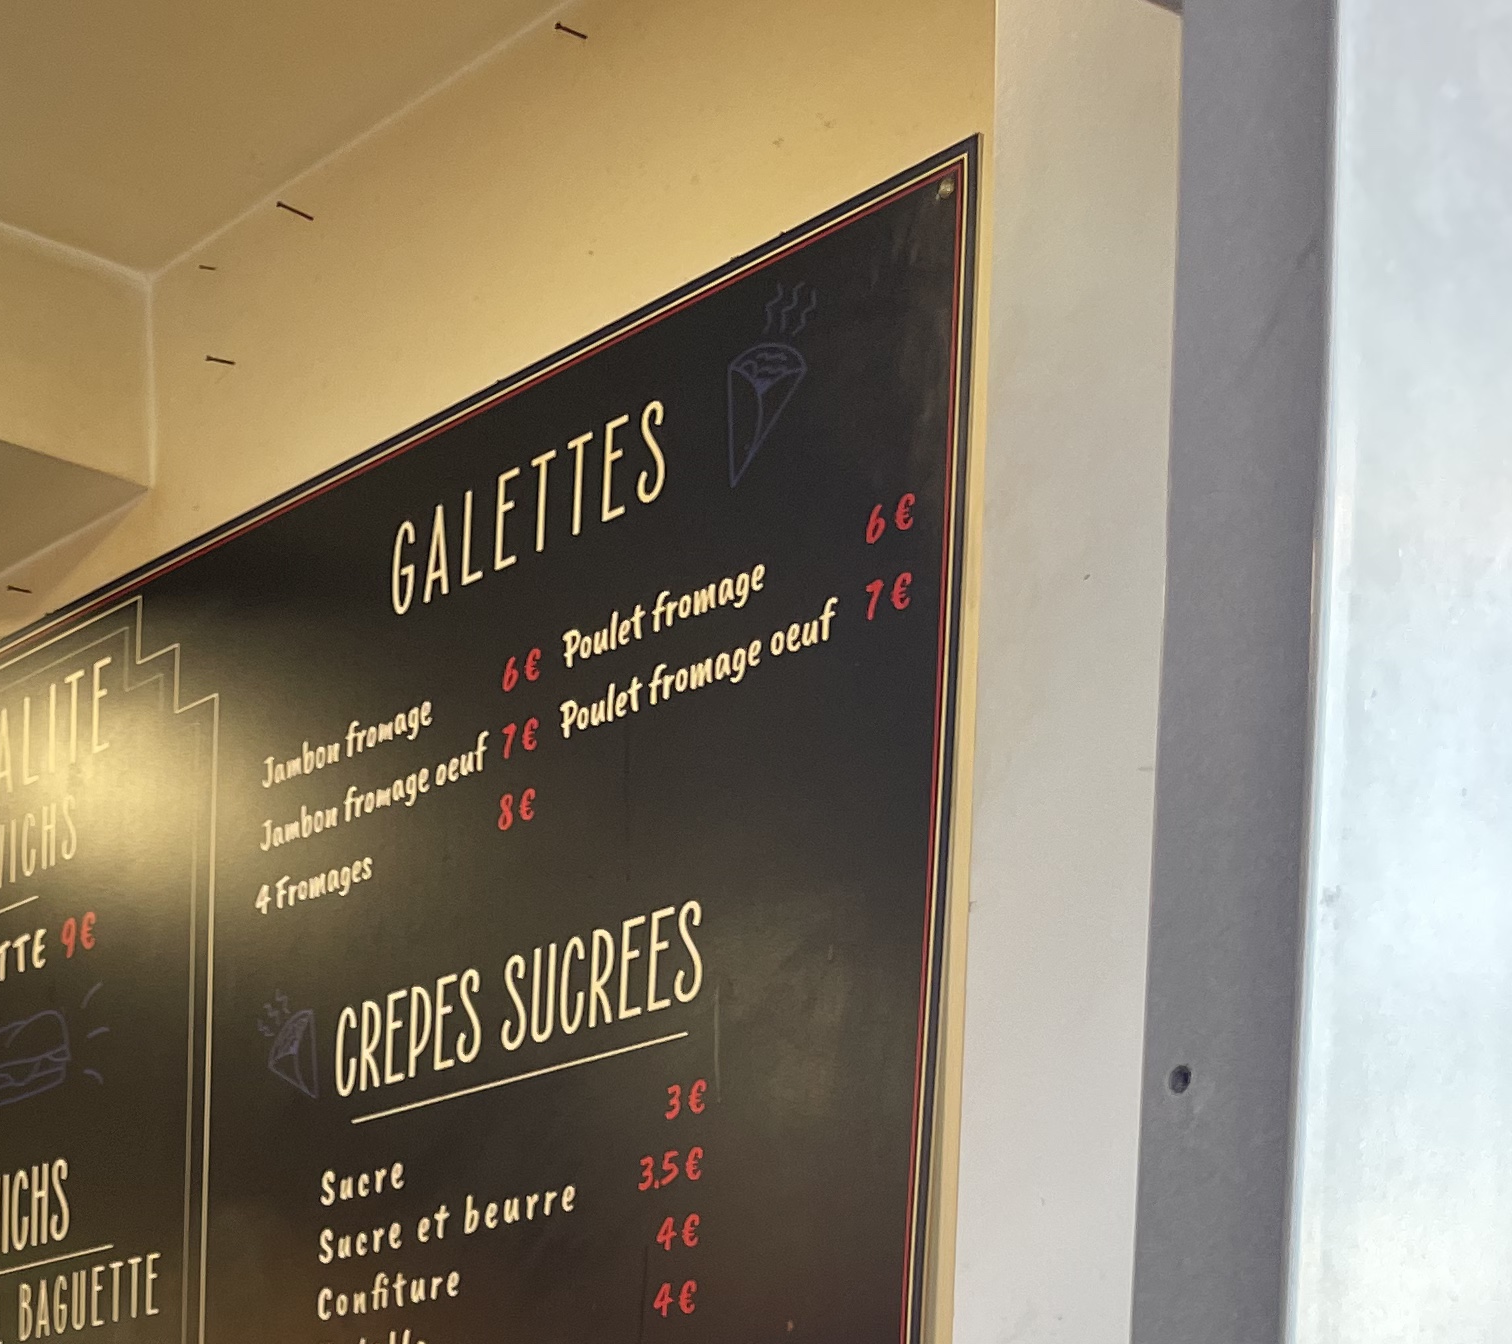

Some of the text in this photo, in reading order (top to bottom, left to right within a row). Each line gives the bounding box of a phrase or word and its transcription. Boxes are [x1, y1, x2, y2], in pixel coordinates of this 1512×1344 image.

[390, 400, 665, 616] GALETTES
[562, 604, 645, 668] Poulet
[651, 564, 766, 635] fromage
[560, 675, 643, 739] Poulet
[649, 636, 761, 707] fromage
[770, 598, 839, 656] oeuf
[261, 727, 340, 789] Jambon
[345, 701, 433, 760] fromage
[260, 792, 338, 852] Jambon
[344, 765, 430, 824] fromage
[436, 730, 490, 786] oeuf
[255, 884, 272, 915] 4
[276, 856, 373, 910] Fromages
[335, 900, 704, 1098] CREPES SUCREES
[318, 1220, 402, 1264] Sucre
[416, 1205, 450, 1244] et
[464, 1183, 577, 1236] beurre
[320, 1161, 406, 1206] Sucre
[18, 1252, 162, 1342] BAGUETTE
[317, 1268, 461, 1320] Confiture
